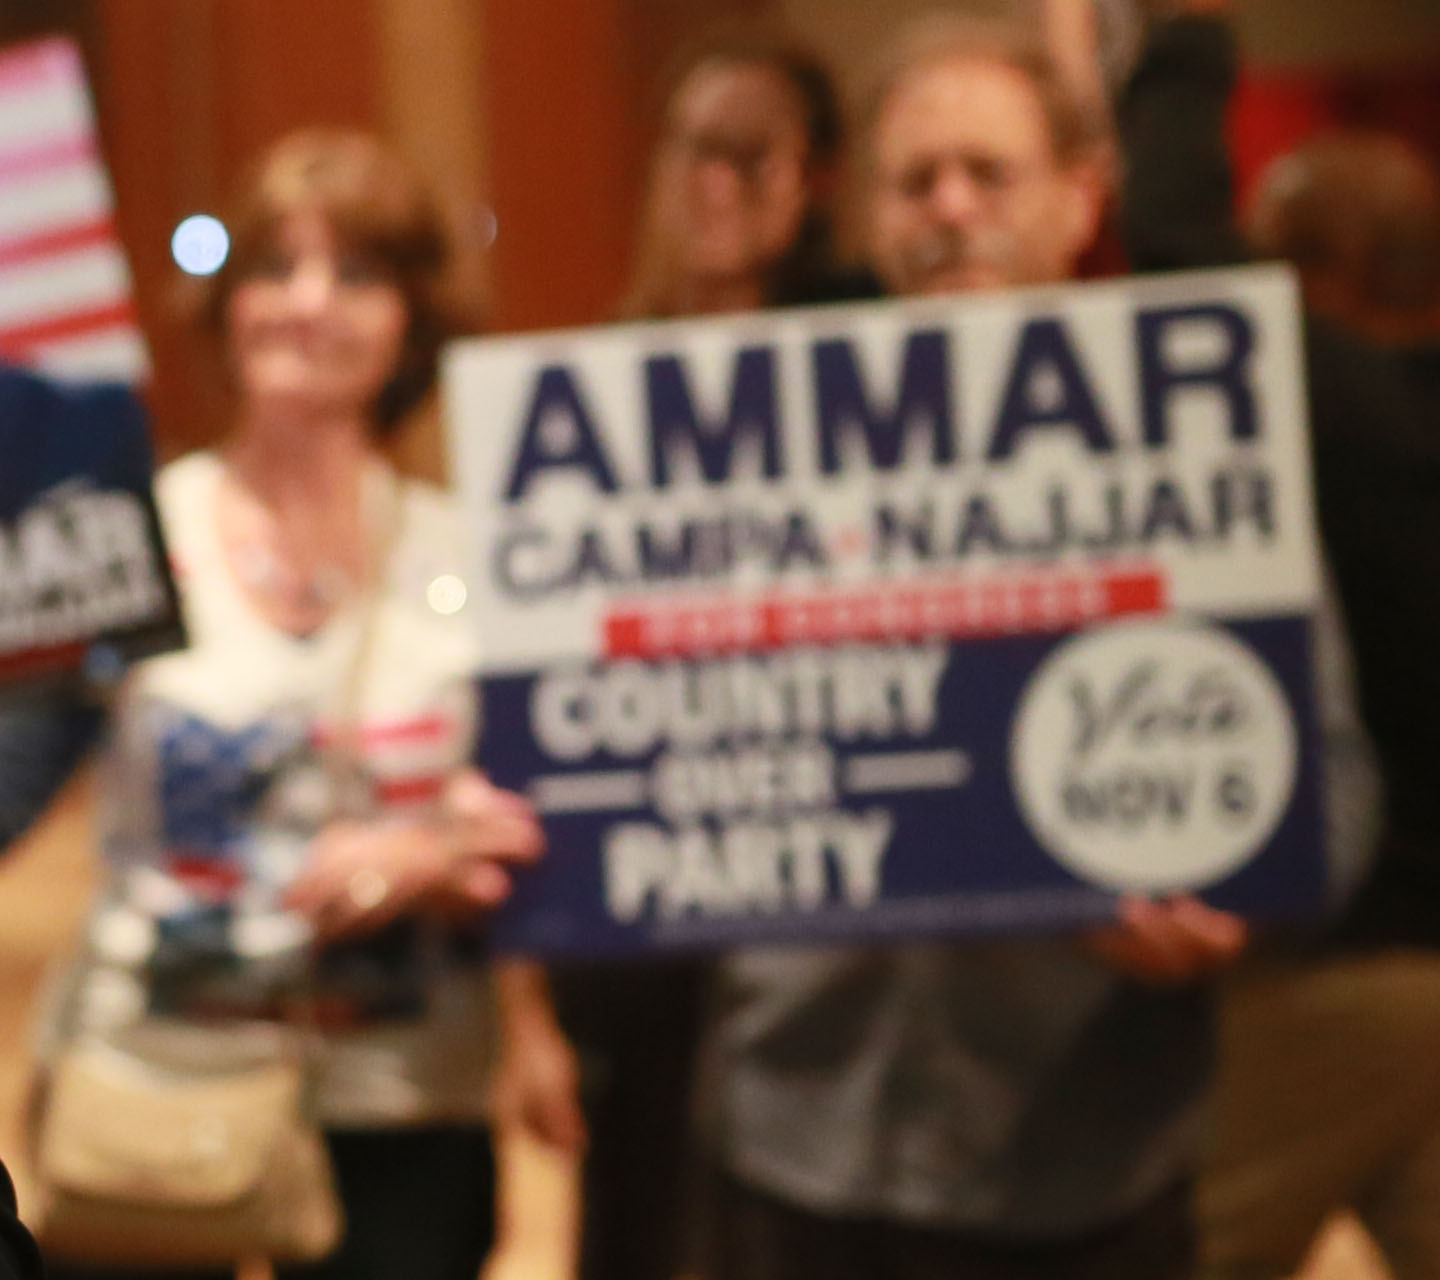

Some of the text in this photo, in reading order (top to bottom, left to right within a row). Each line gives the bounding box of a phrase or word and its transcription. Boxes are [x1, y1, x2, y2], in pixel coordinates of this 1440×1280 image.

[505, 298, 1260, 505] AMMAR
[528, 645, 950, 762] COUNTRY
[602, 815, 892, 925] PARTY
